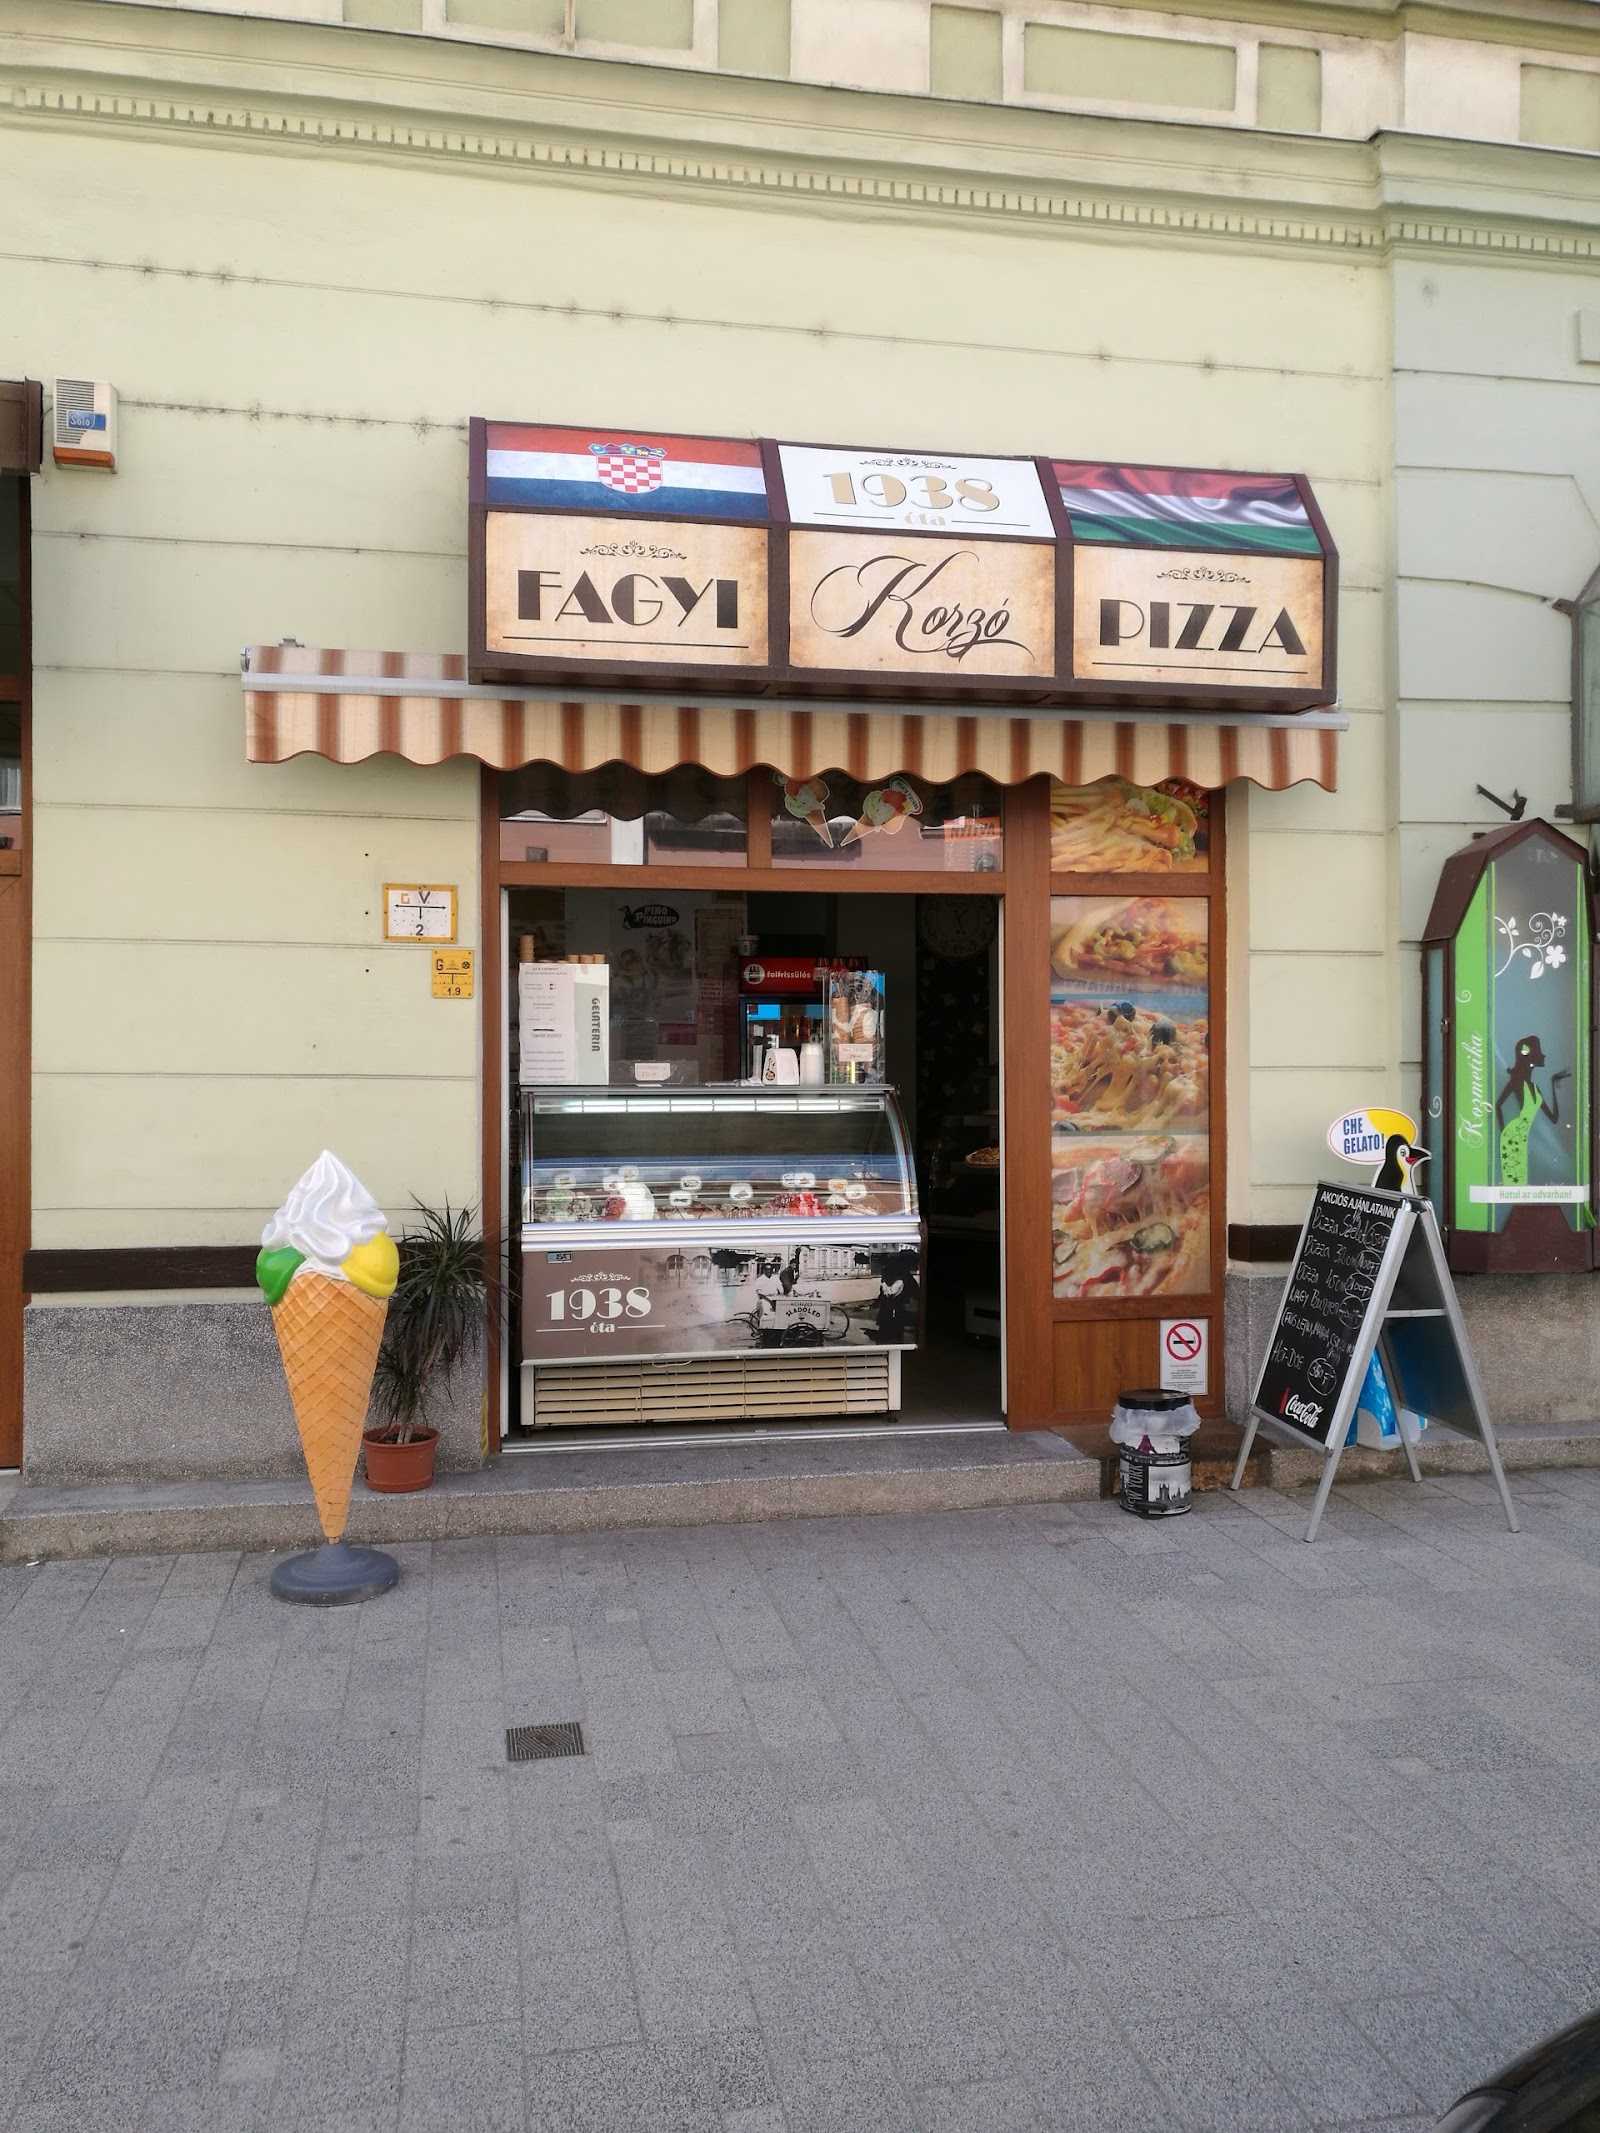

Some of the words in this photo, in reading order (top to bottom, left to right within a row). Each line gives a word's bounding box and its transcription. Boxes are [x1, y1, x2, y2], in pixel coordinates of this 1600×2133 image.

[823, 472, 1000, 512] 1938
[517, 569, 738, 629] FAGYI
[810, 550, 1035, 664] Korzó
[1099, 598, 1307, 656] PIZZA
[415, 923, 424, 936] 2
[436, 959, 444, 971] G
[1458, 1030, 1492, 1148] Kozmetika
[1343, 1118, 1363, 1135] CHE
[1344, 1133, 1385, 1154] GELATO!
[1320, 1190, 1349, 1208] AKCIÓS
[1347, 1196, 1396, 1219] AJÁNLATAINK
[545, 1287, 652, 1321] 1938
[590, 1321, 616, 1334] óta
